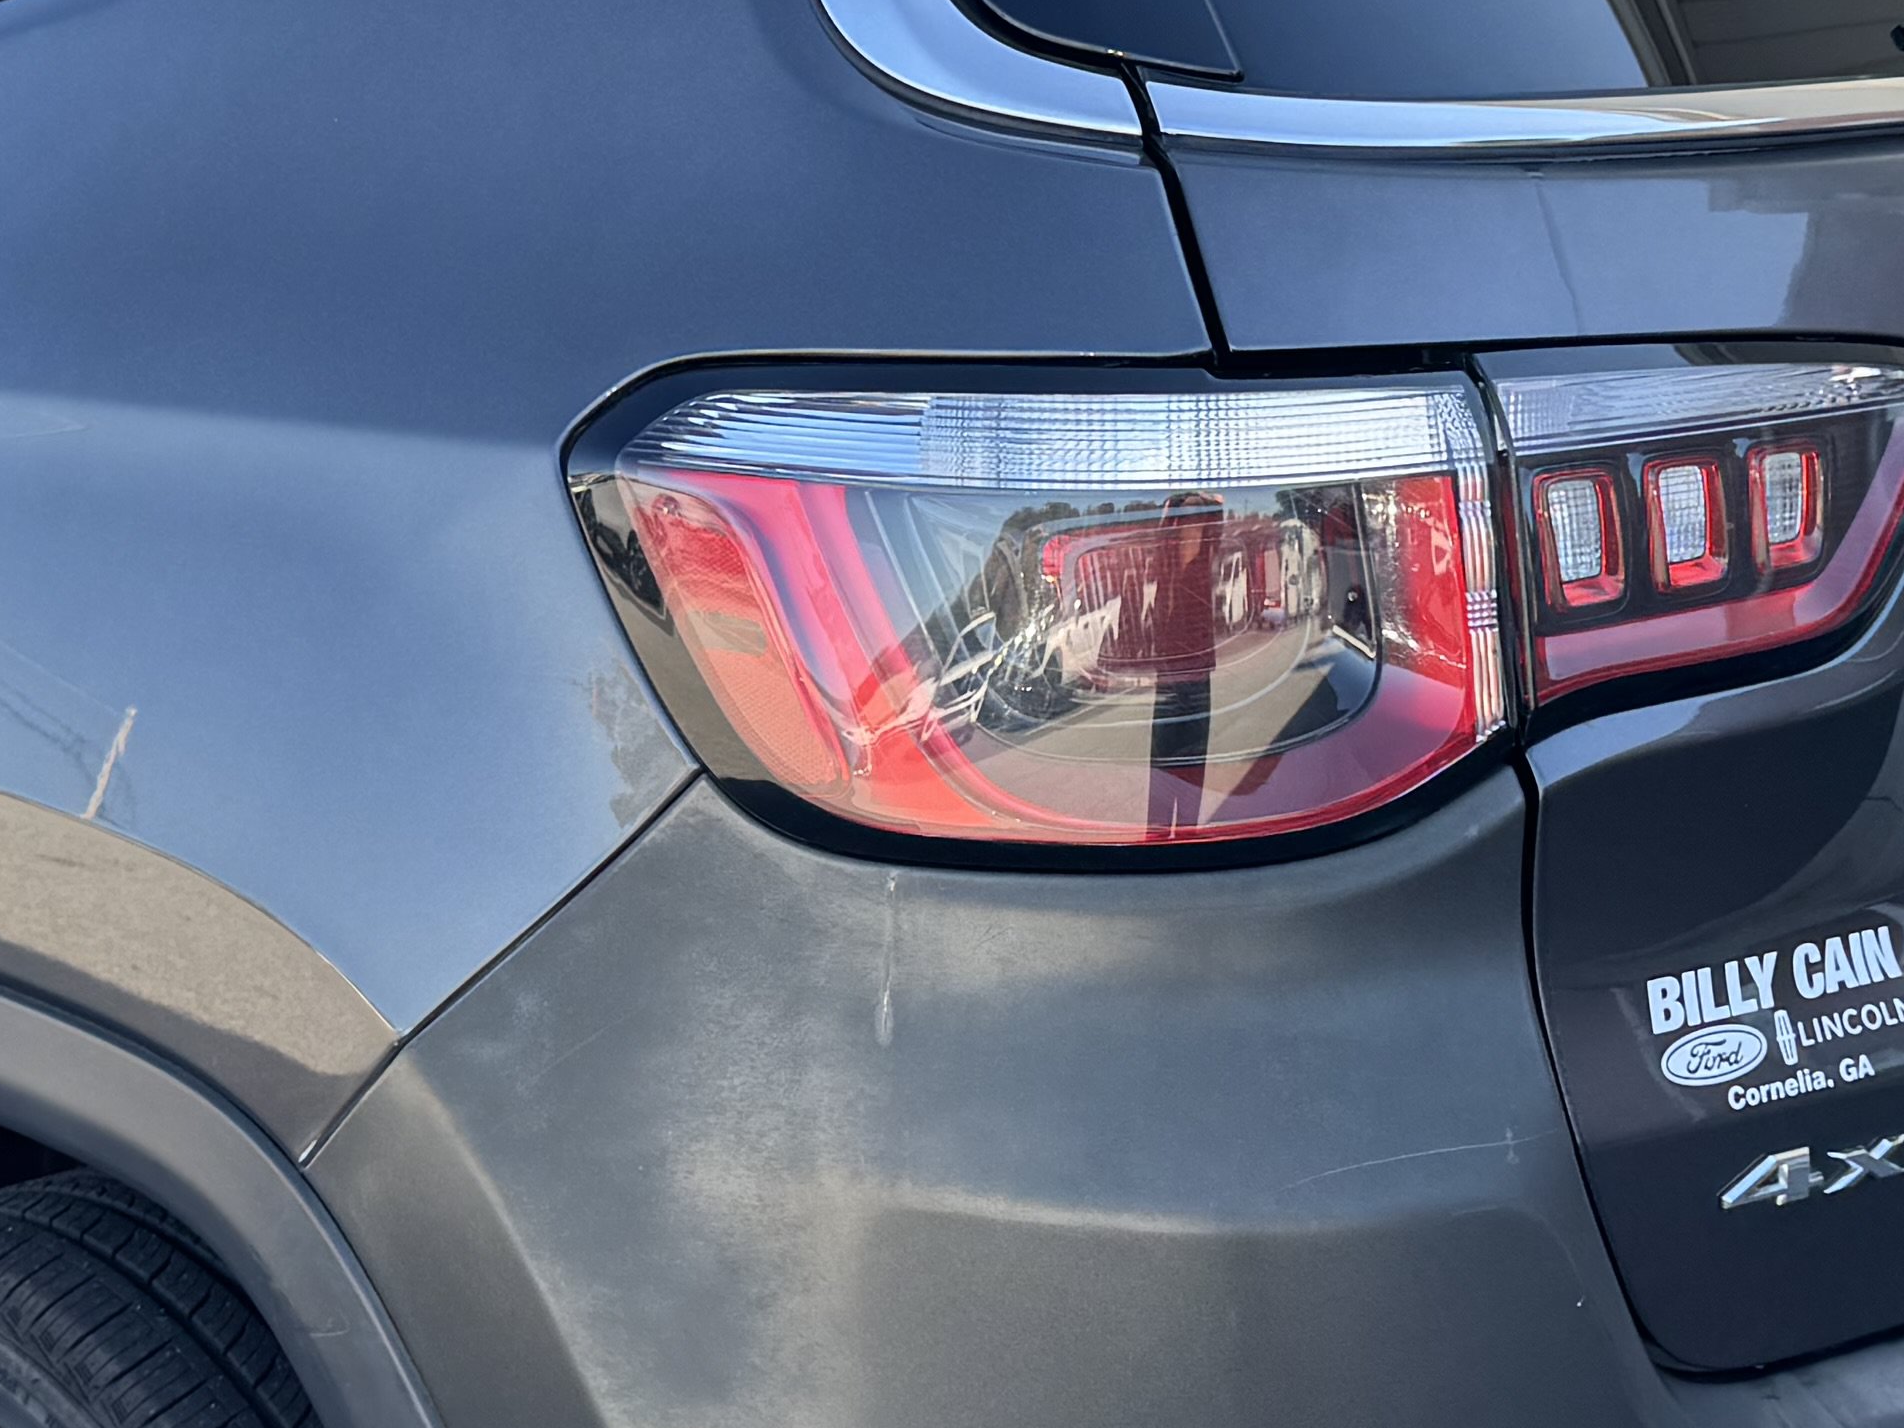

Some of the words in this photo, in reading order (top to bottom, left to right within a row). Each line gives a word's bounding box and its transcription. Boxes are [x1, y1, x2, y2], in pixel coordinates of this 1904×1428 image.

[1647, 951, 1777, 1035] BILLY
[1793, 926, 1903, 999] CAIN
[1687, 1039, 1744, 1075] Ford
[1839, 1054, 1875, 1083] GA
